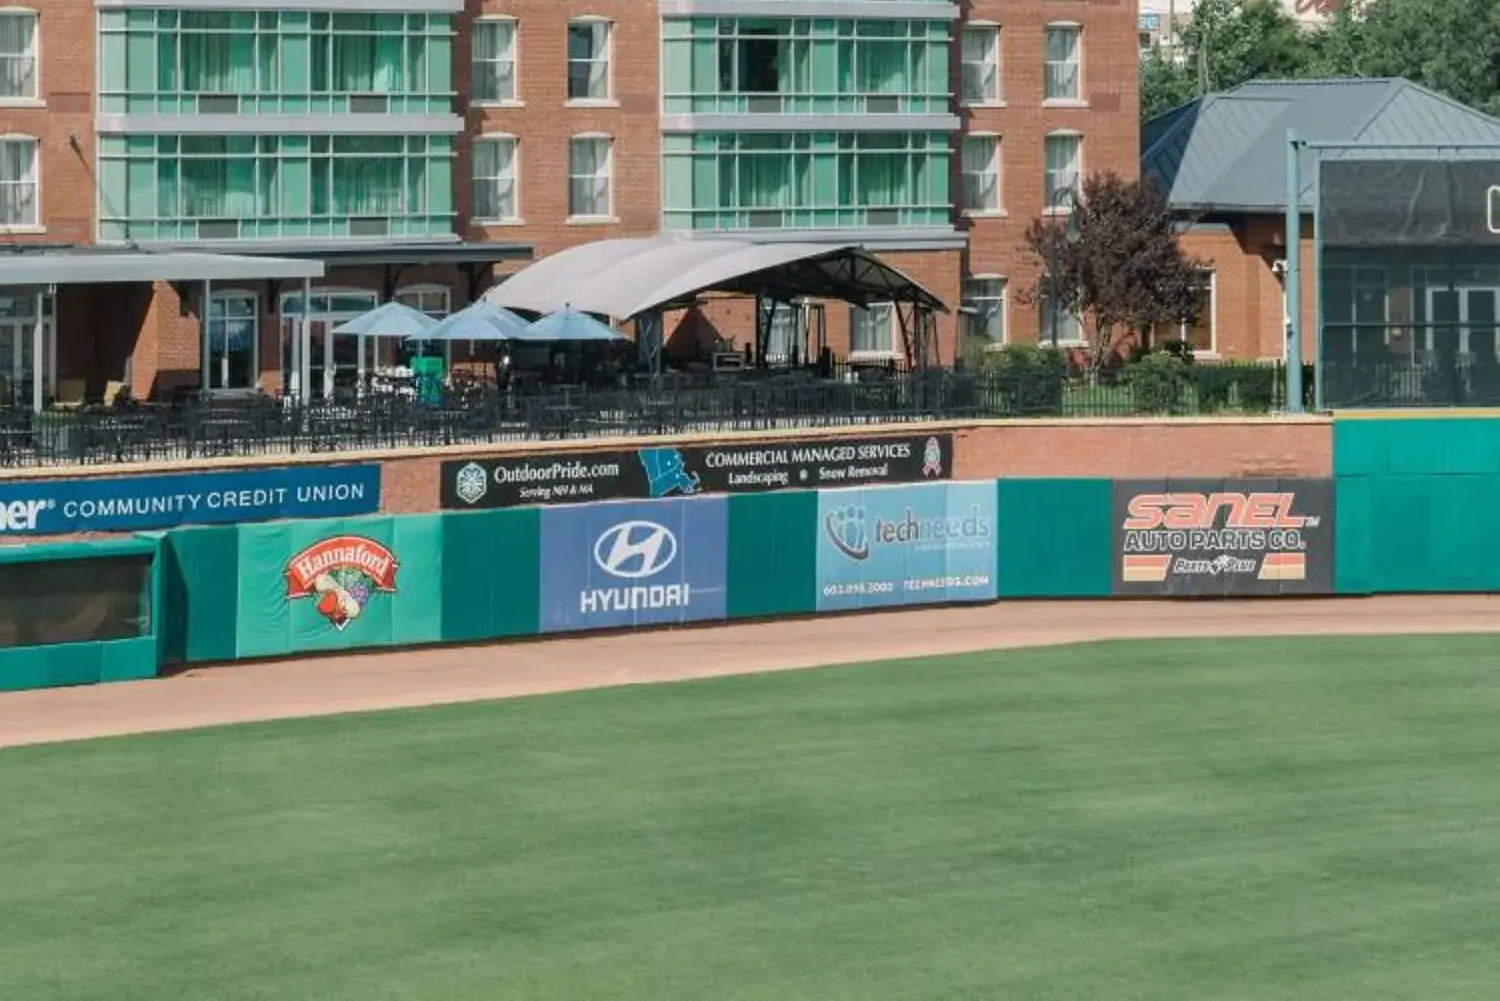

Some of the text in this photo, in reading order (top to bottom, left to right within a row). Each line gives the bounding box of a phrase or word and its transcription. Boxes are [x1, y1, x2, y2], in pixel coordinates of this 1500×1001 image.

[705, 442, 911, 468] COMMERCIAL MANAGED SERVICES
[493, 461, 620, 484] OutdoorPride.com
[728, 469, 789, 485] Landscaping
[63, 494, 200, 518] COMMUNITY
[206, 488, 287, 509] CREDIT
[296, 483, 364, 503] UNION
[875, 501, 990, 544] techneeds
[1124, 529, 1307, 552] AUTO PARTS CO.
[296, 543, 390, 582] Hannaford
[580, 583, 690, 614] HYUNDAI
